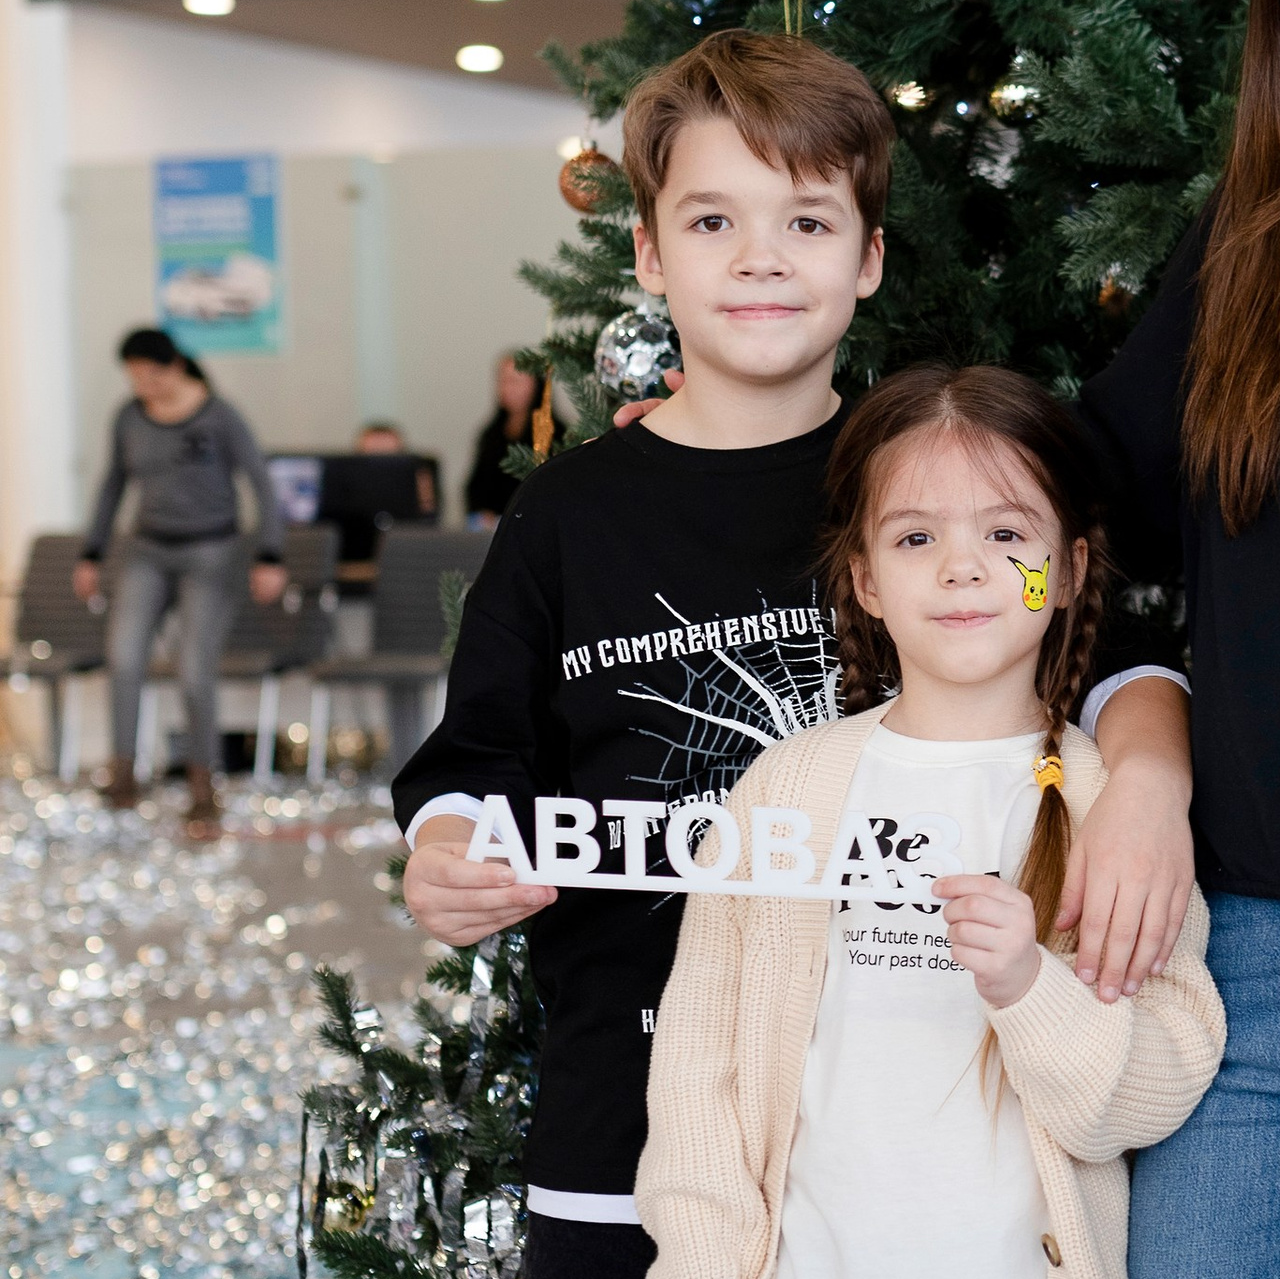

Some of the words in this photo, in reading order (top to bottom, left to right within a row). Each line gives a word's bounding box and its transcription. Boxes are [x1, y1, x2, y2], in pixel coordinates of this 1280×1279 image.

[561, 645, 593, 681] MY
[597, 608, 825, 668] COMPREHENSIVE
[872, 926, 919, 944] futute
[924, 933, 953, 949] nee
[848, 949, 885, 967] Your
[889, 953, 923, 971] past
